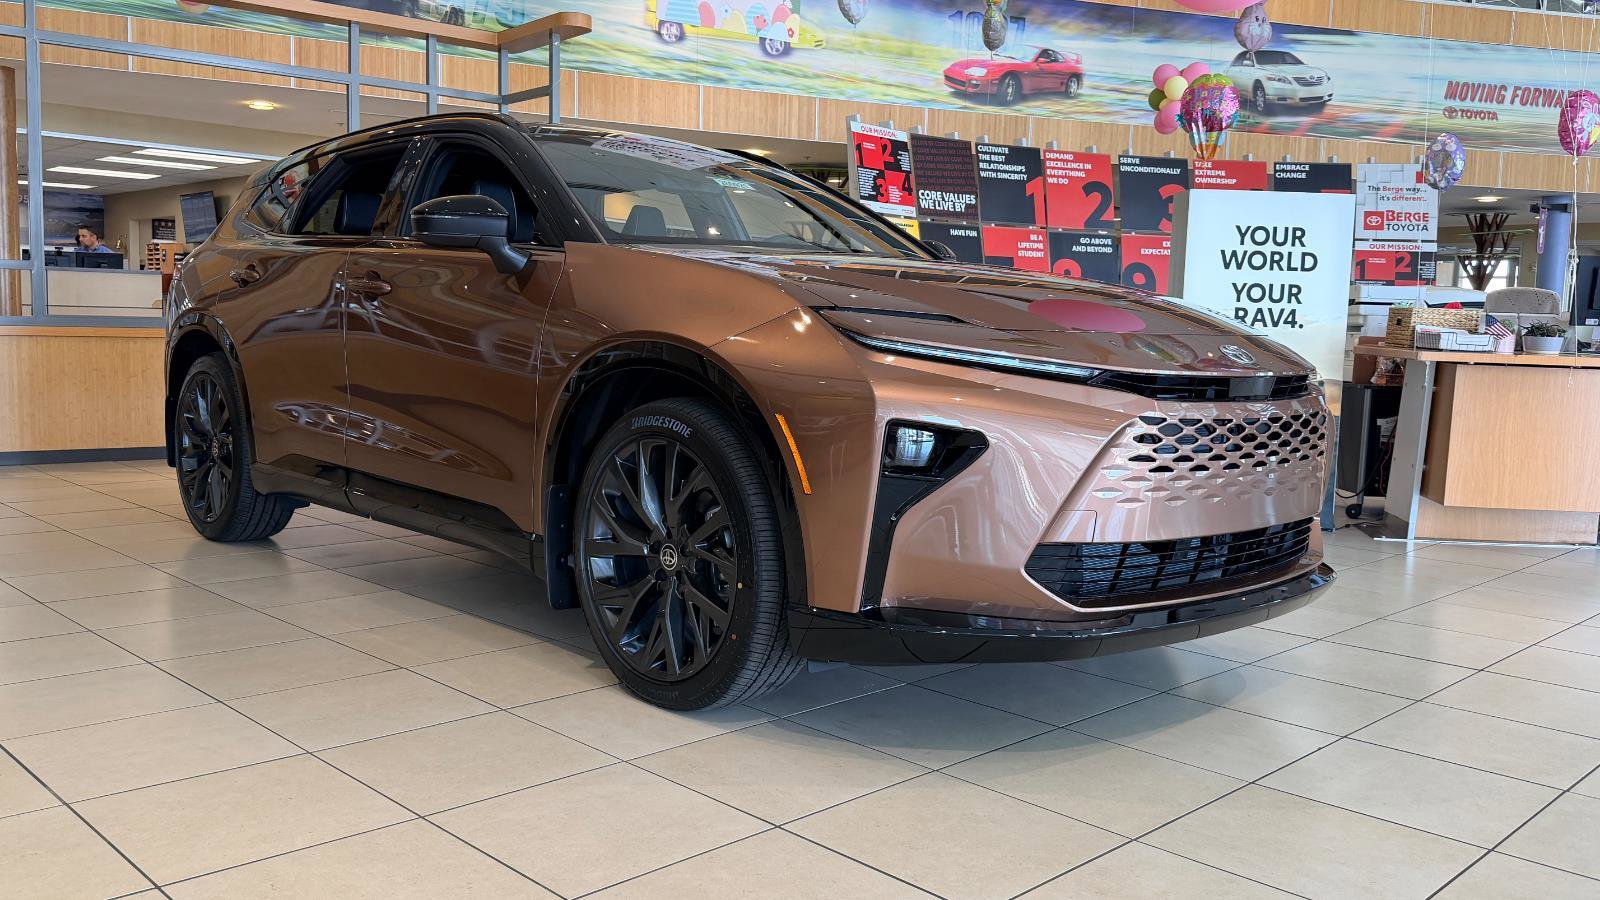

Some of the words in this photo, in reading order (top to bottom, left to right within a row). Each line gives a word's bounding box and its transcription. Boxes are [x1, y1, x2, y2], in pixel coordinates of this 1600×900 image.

[1444, 80, 1508, 105] MOVING
[1509, 85, 1575, 109] FORWA
[1459, 108, 1499, 121] TOYOTA
[860, 125, 873, 135] OUR
[880, 138, 895, 163] 2
[977, 145, 1009, 154] CULTIVATE
[978, 153, 991, 161] THE
[990, 154, 1006, 162] BEST
[1045, 152, 1074, 160] DEMAND
[979, 162, 1026, 172] RELATIONSHIPS
[1046, 161, 1084, 170] EXCELLENCE
[1120, 165, 1181, 175] UNCONDITIONALLY
[996, 172, 1028, 181] SINCERITY
[1047, 169, 1086, 178] EVERYTHING
[1194, 177, 1237, 185] OWNERSHIP
[875, 178, 888, 203] 3
[902, 173, 913, 196] 4
[1382, 185, 1404, 193] Berge
[918, 190, 943, 201] CORE
[943, 192, 977, 204] VALUES
[1025, 175, 1046, 226] 1
[919, 199, 935, 210] WE
[935, 201, 954, 212] LIVE
[955, 203, 966, 213] BY
[1081, 181, 1114, 229] 2
[1385, 210, 1430, 223] BERGE
[1385, 223, 1429, 232] TOYOTA
[950, 228, 966, 237] HAVE
[966, 229, 978, 238] FUN
[1235, 224, 1306, 247] YOUR
[1017, 241, 1044, 250] LIFETIME
[1387, 243, 1423, 251] MISSION:
[1017, 250, 1044, 258] STUDENT
[1140, 248, 1171, 256] EXPECTAT
[1220, 249, 1318, 272] WORLD
[1395, 251, 1412, 273] 2
[1231, 282, 1303, 304] YOUR
[1234, 306, 1304, 329] RAV4.
[631, 415, 693, 438] BRIDGESTONE
